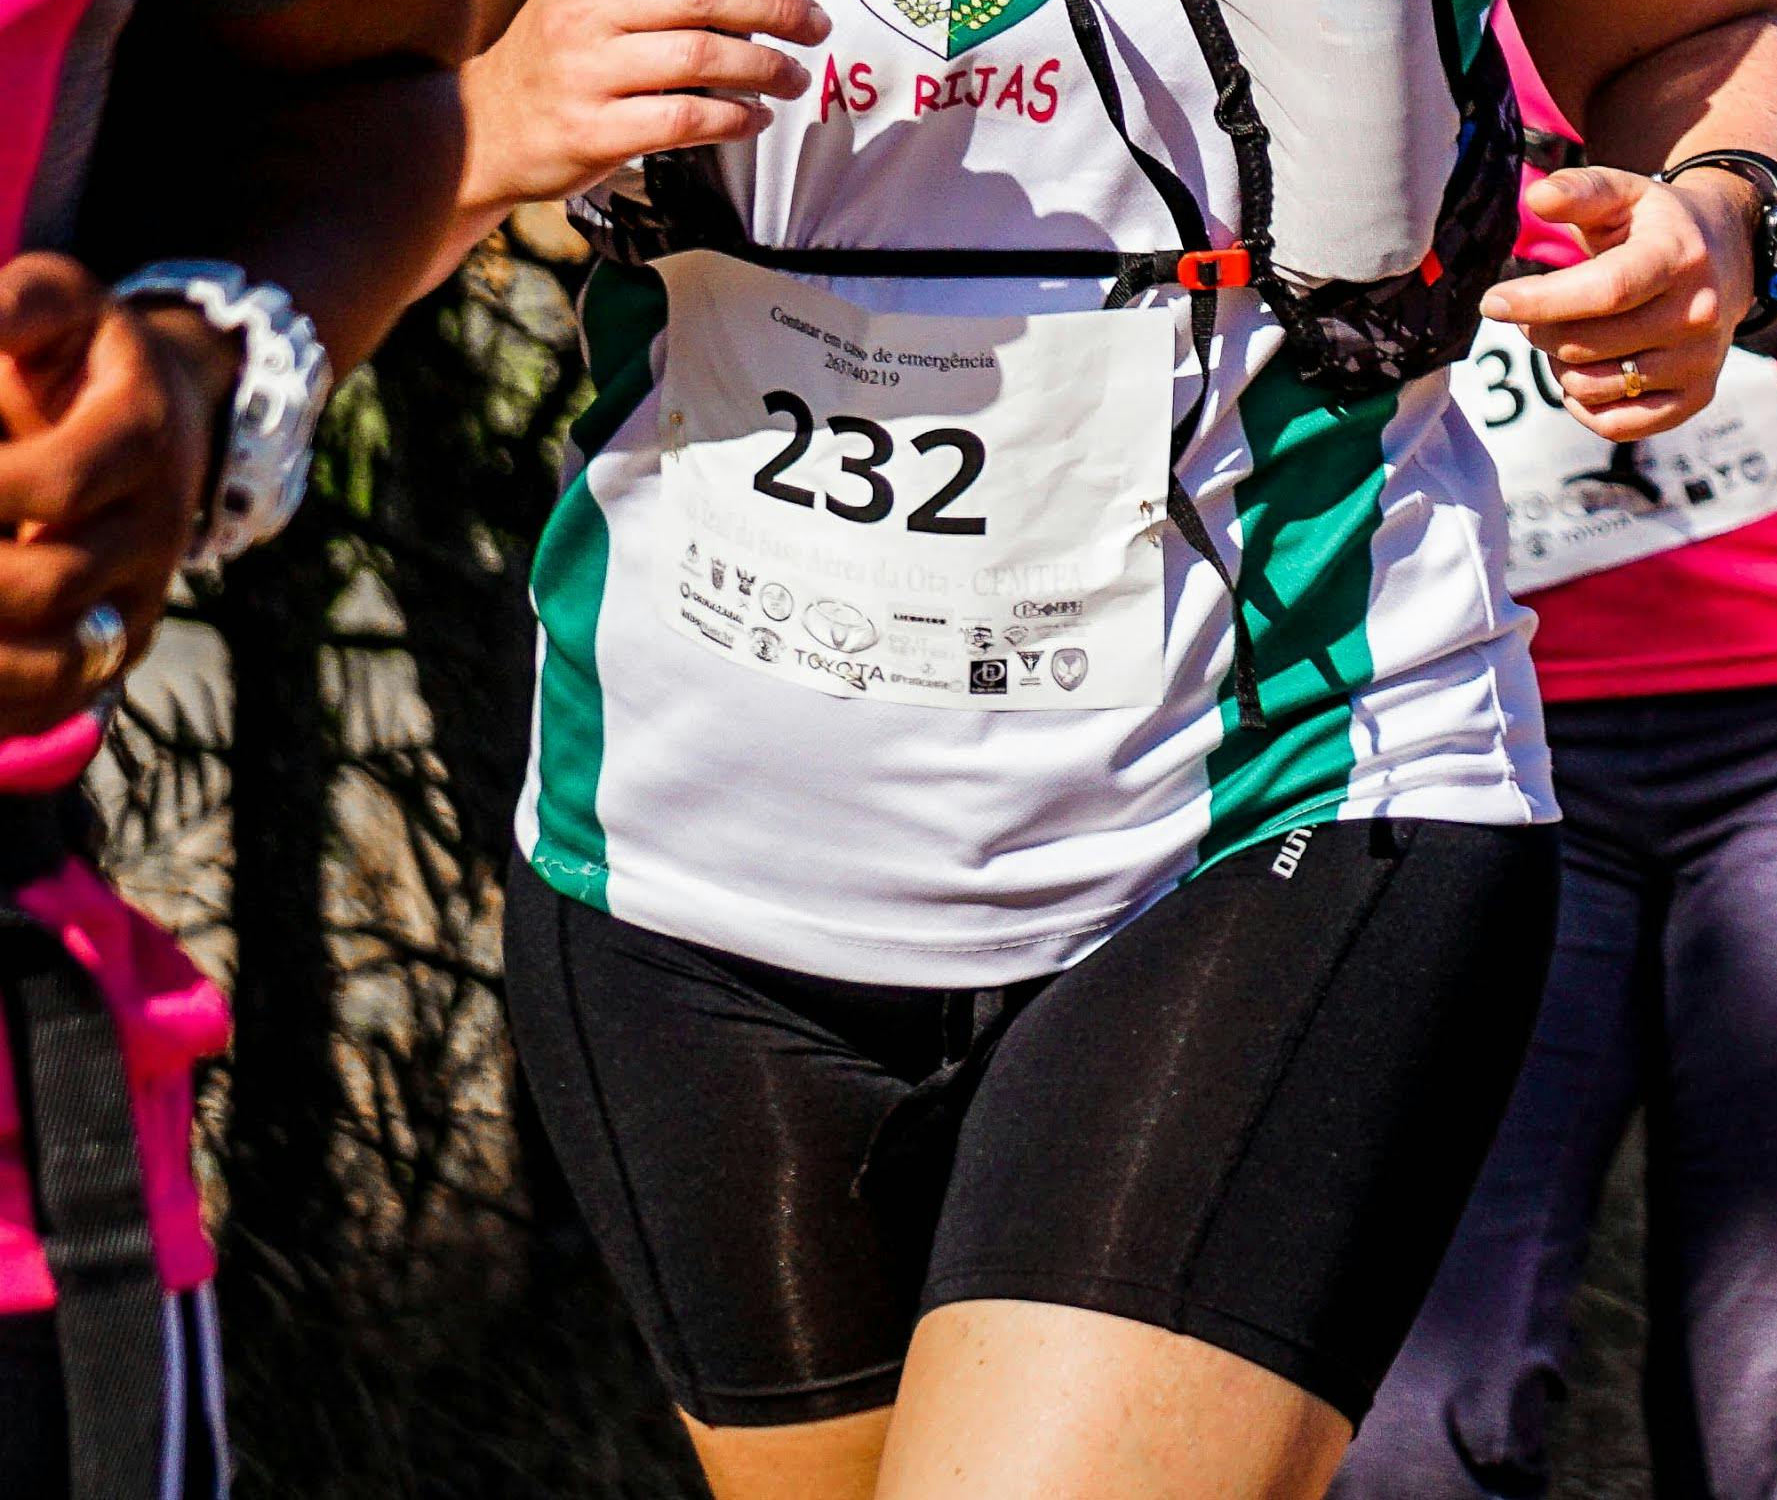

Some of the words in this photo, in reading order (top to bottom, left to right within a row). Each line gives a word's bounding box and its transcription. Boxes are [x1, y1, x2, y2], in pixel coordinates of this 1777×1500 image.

[914, 58, 1061, 123] RIJAS
[872, 347, 893, 364] de
[897, 350, 996, 373] emergência
[752, 390, 989, 537] 232
